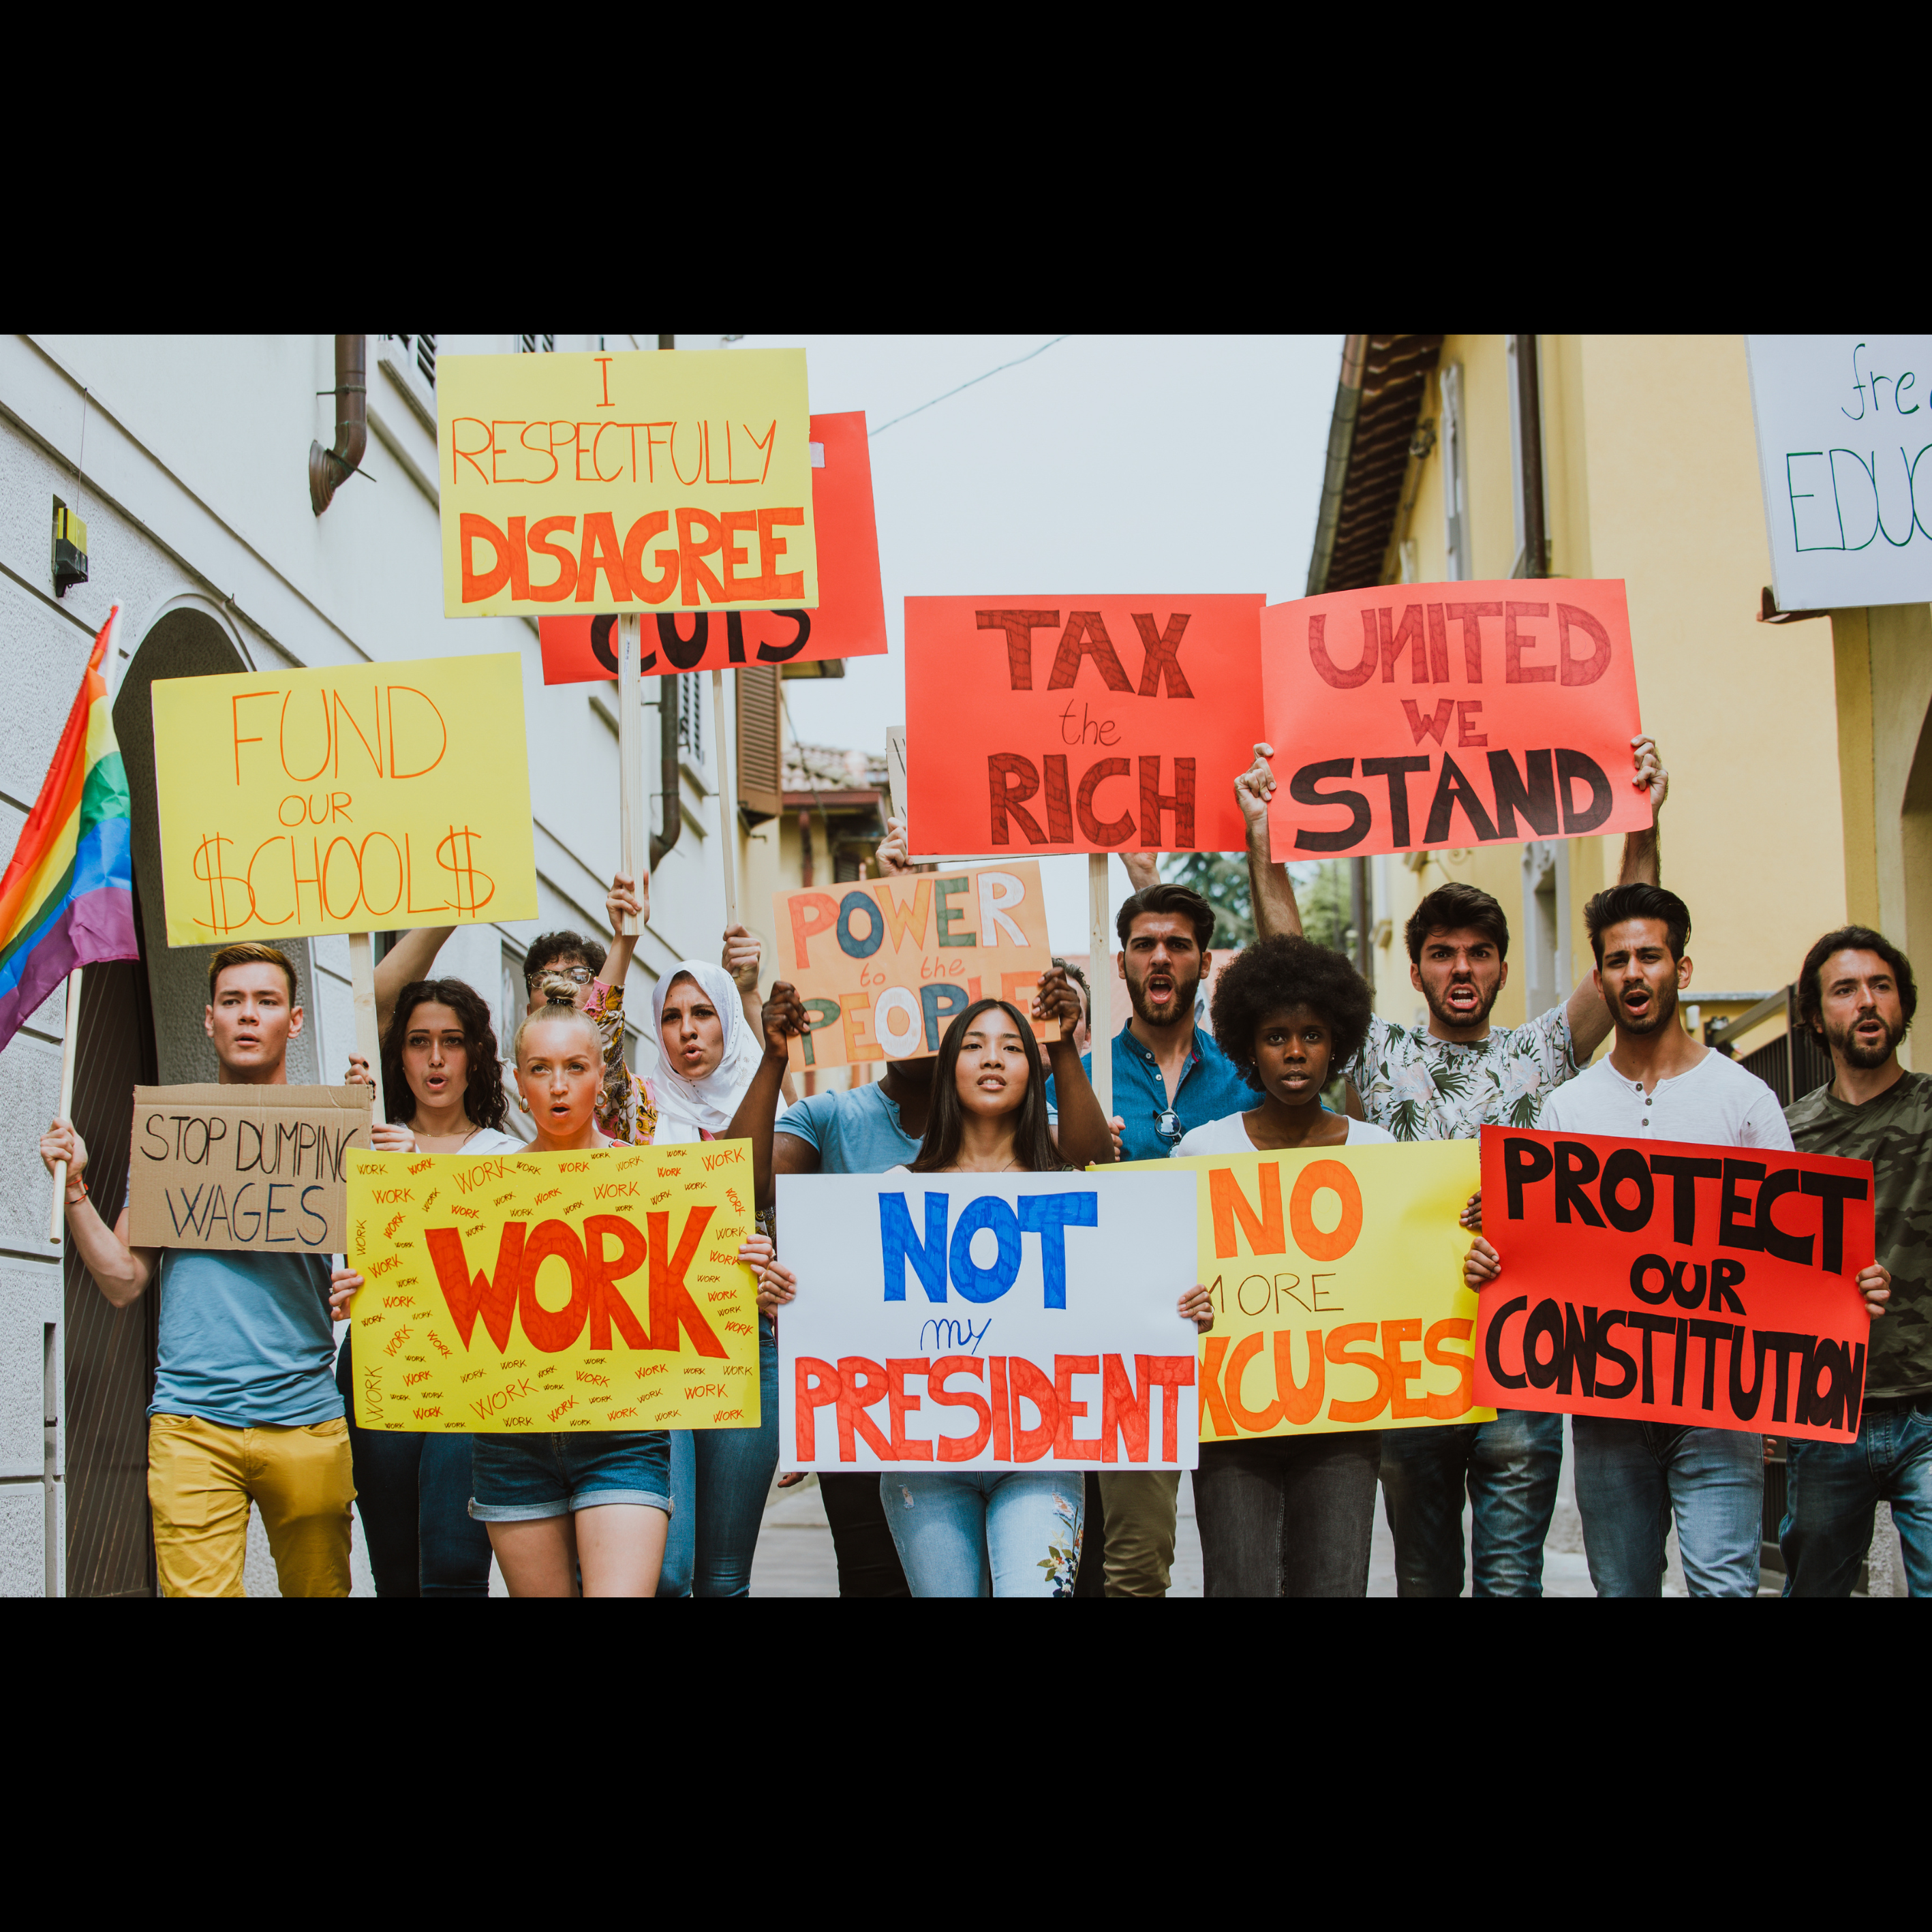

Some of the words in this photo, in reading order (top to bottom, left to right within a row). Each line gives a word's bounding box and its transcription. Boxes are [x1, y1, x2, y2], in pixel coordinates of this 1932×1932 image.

[594, 357, 615, 408] I
[1841, 343, 1932, 420] fre
[452, 417, 777, 485] RESPECTFULLY
[459, 506, 806, 607] DISAGREE
[975, 609, 1195, 699] TAX
[1308, 600, 1612, 690] UNITED
[1058, 699, 1122, 746] the
[1400, 699, 1488, 748] WE
[232, 686, 447, 786] FUND
[278, 791, 354, 827] OUR
[987, 752, 1197, 849] RICH
[1289, 748, 1613, 853] STAND
[193, 825, 495, 936] $CHOOL$
[787, 871, 1031, 970] POWER
[860, 962, 886, 987] to
[921, 956, 966, 979] the
[140, 1114, 227, 1166] STOP
[666, 1150, 688, 1158] WORK
[701, 1148, 746, 1172] WORK
[357, 1164, 388, 1175] WORK
[408, 1158, 435, 1176] WORK
[517, 1161, 541, 1175] WORK
[558, 1161, 590, 1174] WORK
[615, 1156, 644, 1171] WORK
[657, 1167, 681, 1178] WORK
[453, 1157, 516, 1194] WORK
[594, 1181, 640, 1200] WORK
[685, 1182, 707, 1191] WORK
[372, 1189, 415, 1204] WORK
[422, 1188, 440, 1212] WORK
[493, 1191, 517, 1206] WORK
[534, 1188, 562, 1206] WORK
[650, 1189, 672, 1206] WORK
[725, 1188, 746, 1216] WORK
[165, 1182, 328, 1246] WAGES
[452, 1205, 479, 1218] WORK
[510, 1208, 534, 1217] WORK
[563, 1200, 585, 1215] WORK
[615, 1204, 634, 1212] WORK
[1208, 1159, 1363, 1262] NO
[1503, 1137, 1869, 1276] PROTECT
[384, 1212, 406, 1239] WORK
[465, 1223, 487, 1237] WORK
[716, 1226, 748, 1240] WORK
[355, 1220, 367, 1256] WORK
[878, 1191, 1098, 1310] NOT
[368, 1254, 403, 1278] WORK
[396, 1276, 419, 1288] WORK
[424, 1206, 731, 1360] WORK
[697, 1274, 720, 1283] WORK
[1629, 1253, 1747, 1316] OUR
[383, 1295, 416, 1308] WORK
[707, 1289, 737, 1302] WORK
[361, 1313, 386, 1327] WORK
[412, 1310, 433, 1321] WORK
[718, 1306, 741, 1317] WORK
[724, 1321, 754, 1336] WORK
[920, 1318, 992, 1355] my
[383, 1324, 414, 1357] WORK
[427, 1330, 453, 1360] WORK
[500, 1360, 527, 1370] WORK
[538, 1365, 557, 1378] WORK
[634, 1364, 669, 1379] WORK
[723, 1366, 753, 1376] WORK
[1485, 1295, 1866, 1434] CONSTITUTION
[403, 1370, 433, 1387] WORK
[460, 1368, 487, 1383] WORK
[576, 1370, 611, 1387] WORK
[1198, 1317, 1475, 1437] XCUSES
[365, 1366, 384, 1423] WORK
[470, 1378, 539, 1420] WORK
[589, 1395, 613, 1404] WORK
[637, 1388, 663, 1403] WORK
[684, 1383, 729, 1400] WORK
[413, 1406, 444, 1420] WORK
[547, 1395, 579, 1422] WORK
[607, 1407, 639, 1422] WORK
[655, 1409, 681, 1422] WORK
[714, 1409, 744, 1423] WORK
[795, 1353, 1195, 1464] PRESIDENT
[502, 1417, 534, 1427] WORK
